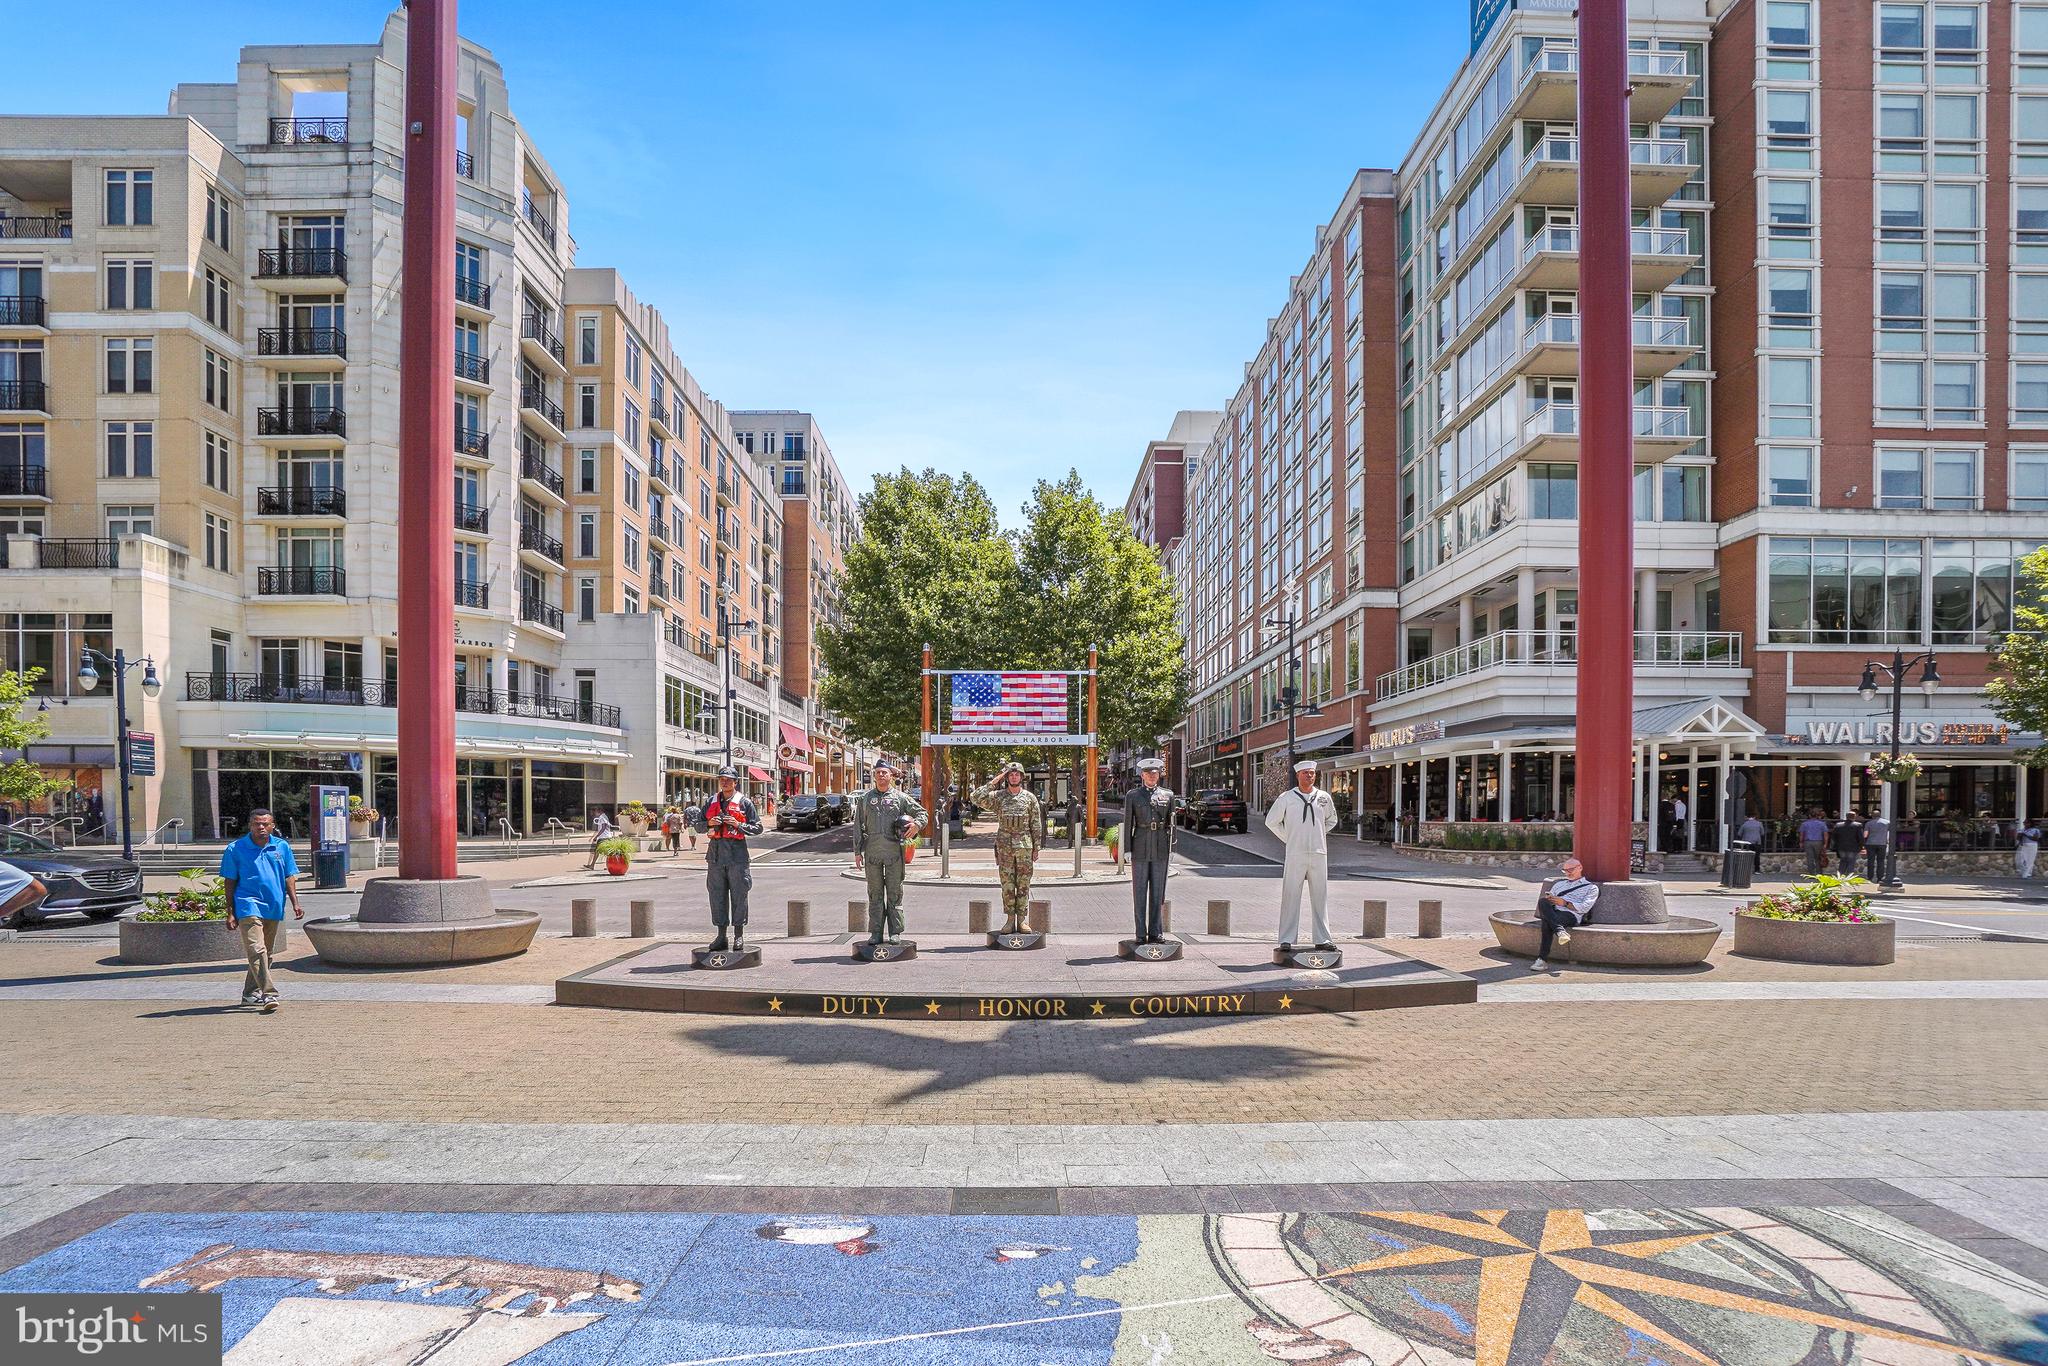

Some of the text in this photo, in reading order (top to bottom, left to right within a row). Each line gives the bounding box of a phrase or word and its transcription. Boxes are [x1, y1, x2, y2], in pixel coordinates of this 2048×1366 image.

[454, 638, 494, 648] HARBOR
[1369, 725, 1415, 751] WALRUS
[1808, 721, 1938, 745] WALRUS
[822, 994, 1246, 1016] DUTY HONOR COUNTRY
